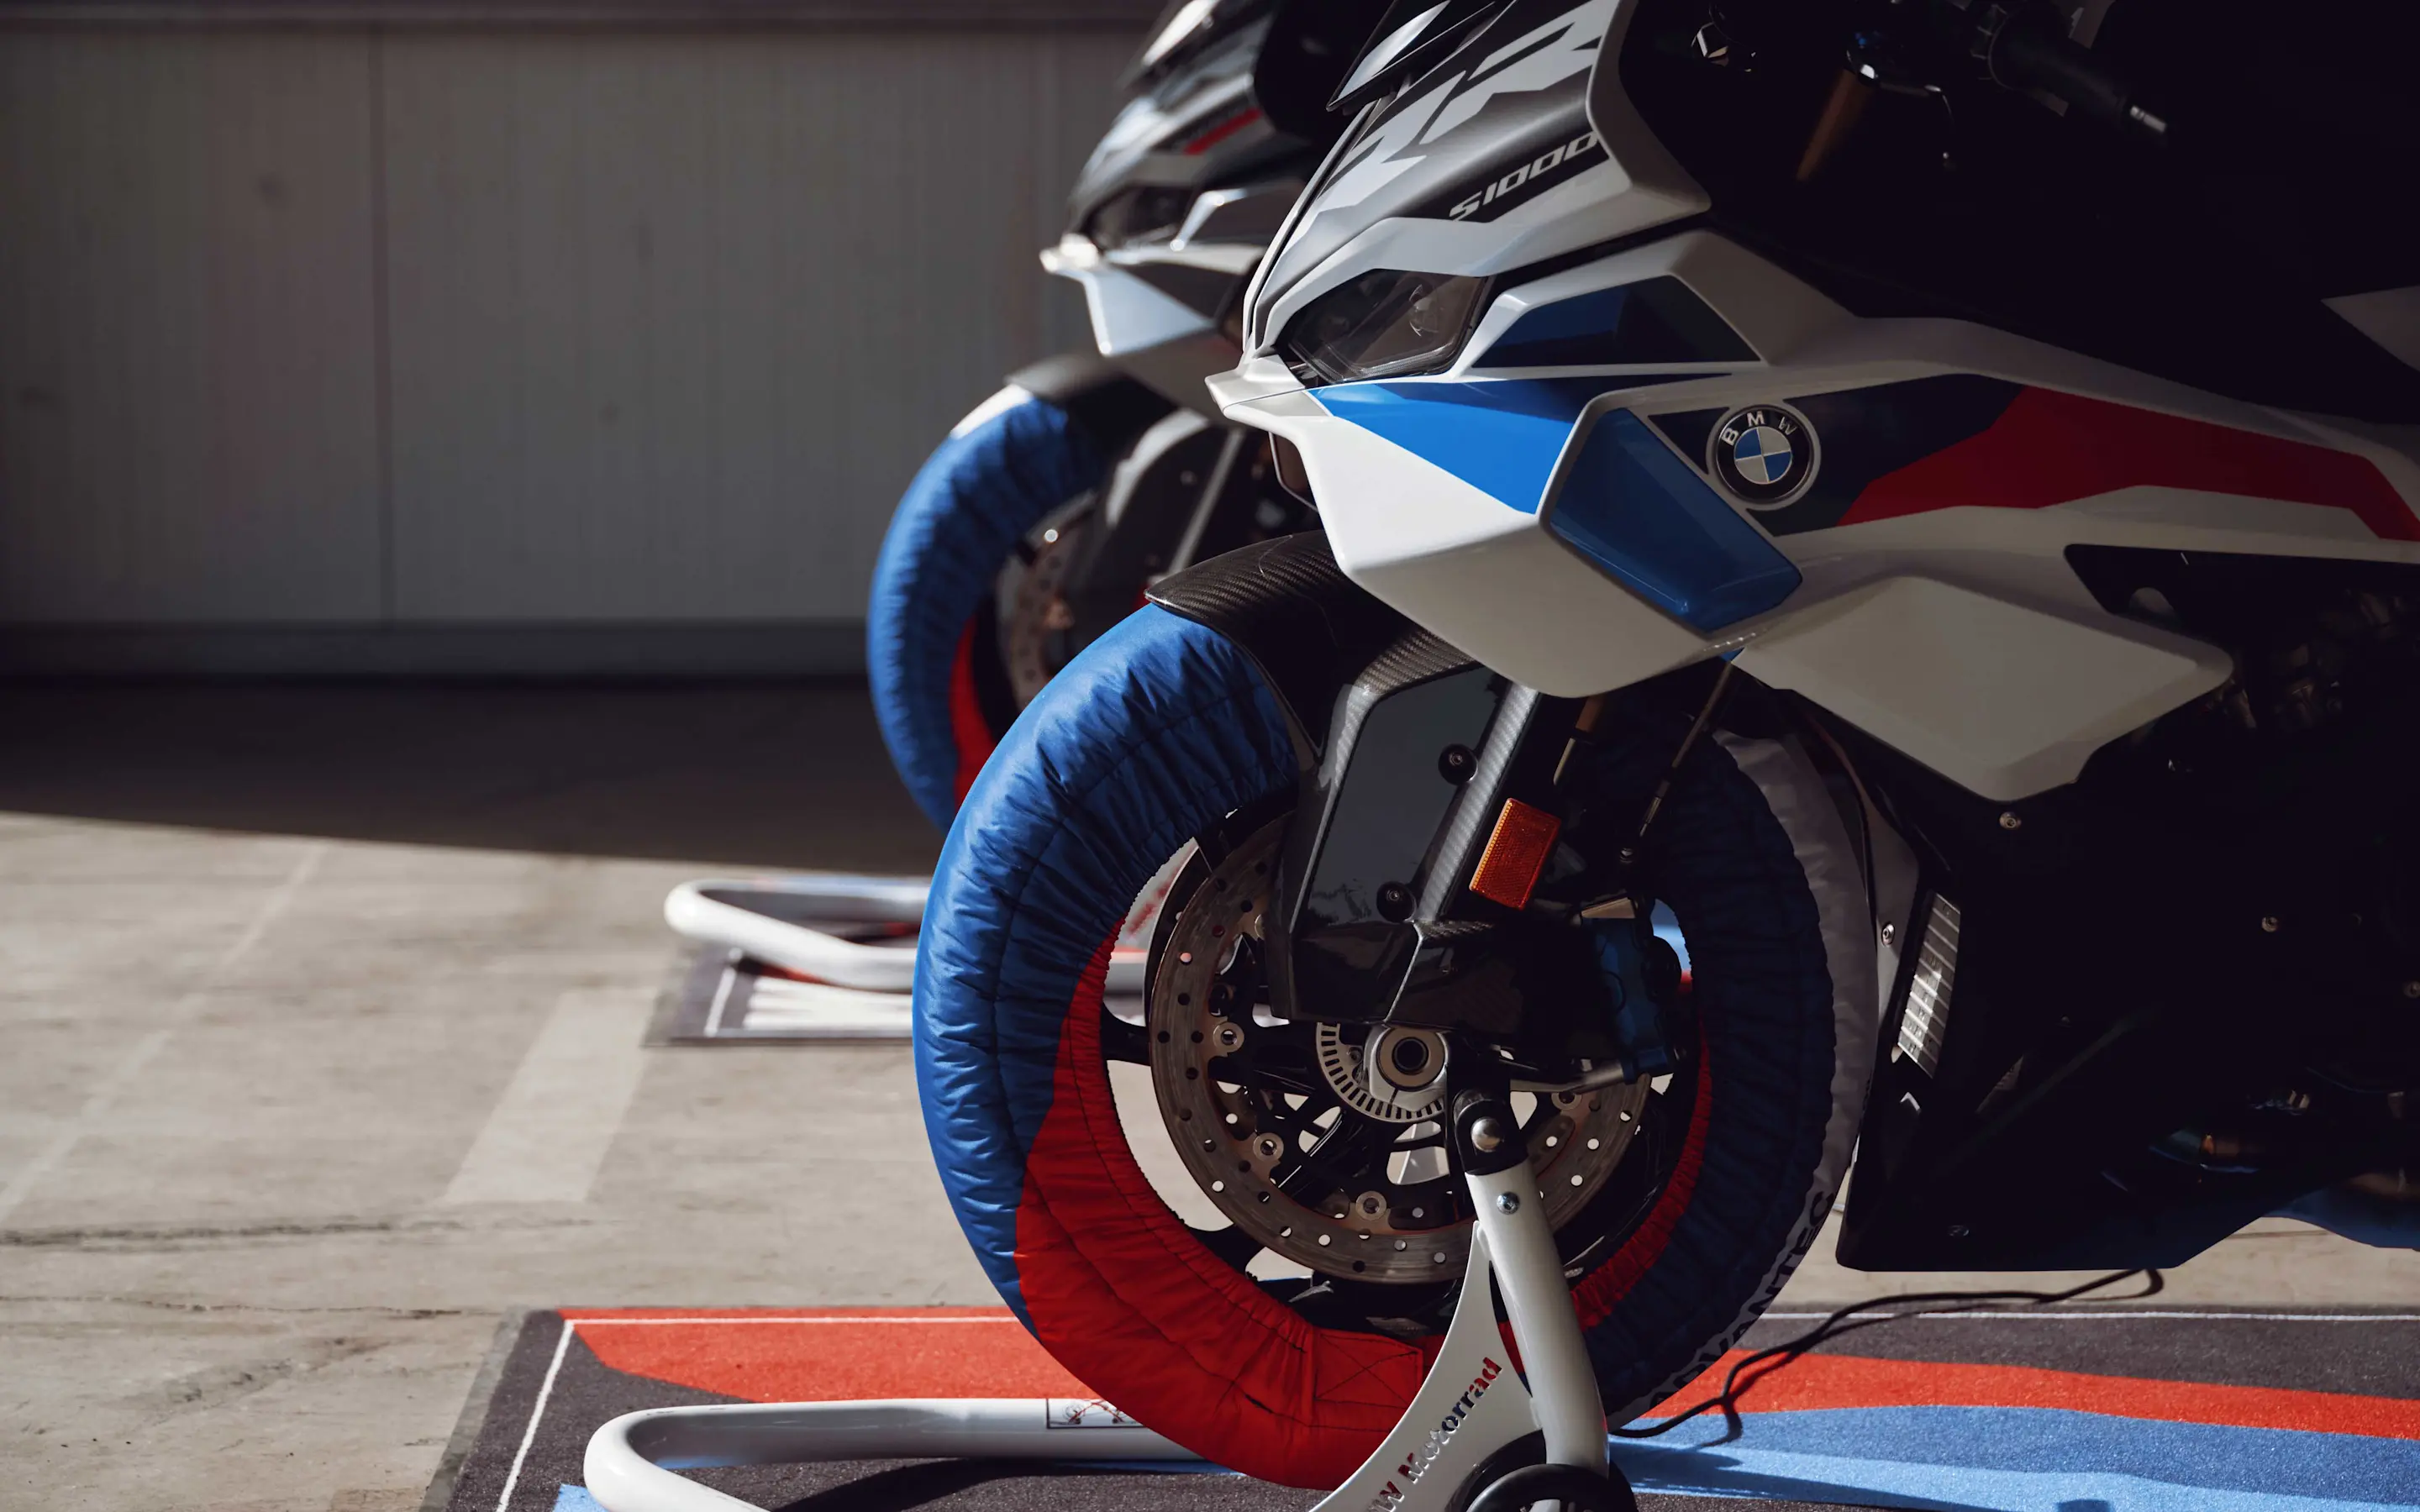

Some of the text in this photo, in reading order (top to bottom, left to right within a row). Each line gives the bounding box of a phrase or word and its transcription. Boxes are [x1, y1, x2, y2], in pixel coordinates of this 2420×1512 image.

[1449, 130, 1599, 222] S1000
[1721, 410, 1798, 446] BMW
[1397, 1357, 1502, 1484] Motorrad
